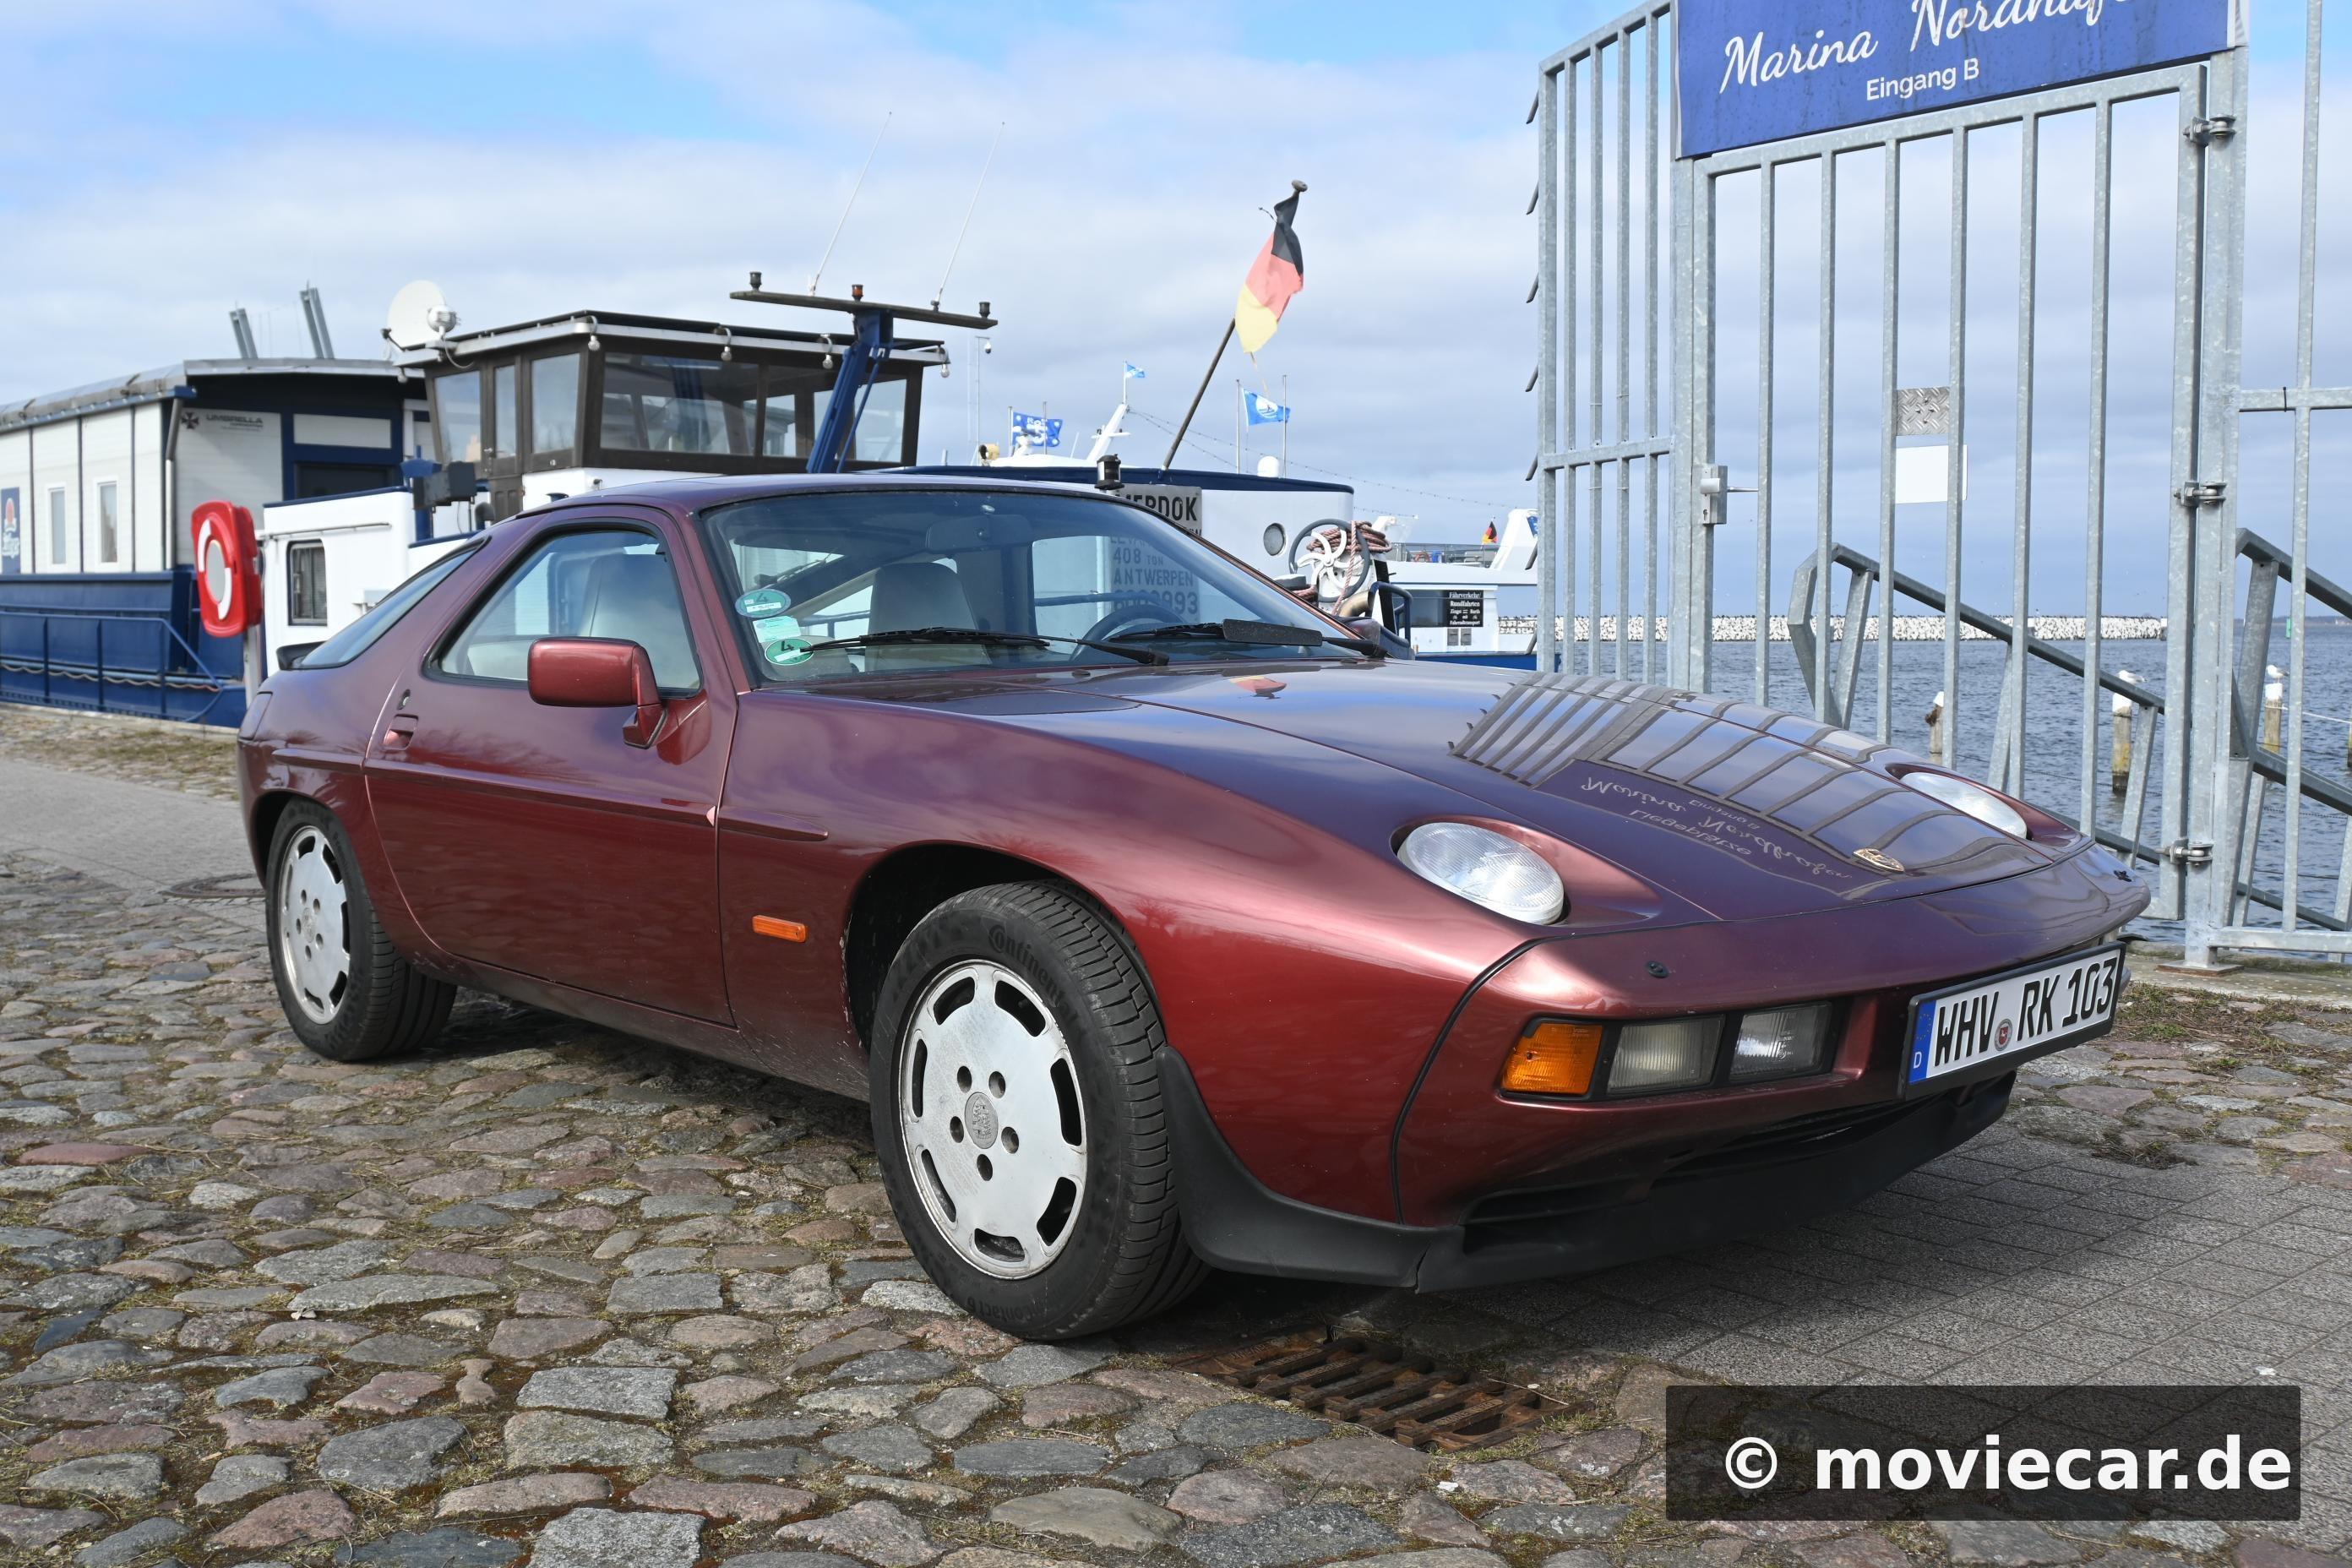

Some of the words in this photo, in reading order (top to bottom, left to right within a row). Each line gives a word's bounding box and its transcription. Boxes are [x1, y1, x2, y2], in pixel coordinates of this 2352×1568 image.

[1718, 29, 1879, 94] Marina
[1866, 67, 1957, 101] Eingang
[1963, 57, 1979, 80] B
[1114, 494, 1198, 521] DOK
[1113, 547, 1141, 564] 408
[1146, 555, 1163, 566] TON
[1113, 568, 1194, 587] ANTWERPEN
[755, 592, 769, 603] 4
[781, 640, 795, 652] 4
[1913, 1051, 1922, 1069] D
[1935, 991, 2000, 1066] WHV
[2017, 974, 2061, 1042] RK
[2062, 956, 2118, 1027] 103
